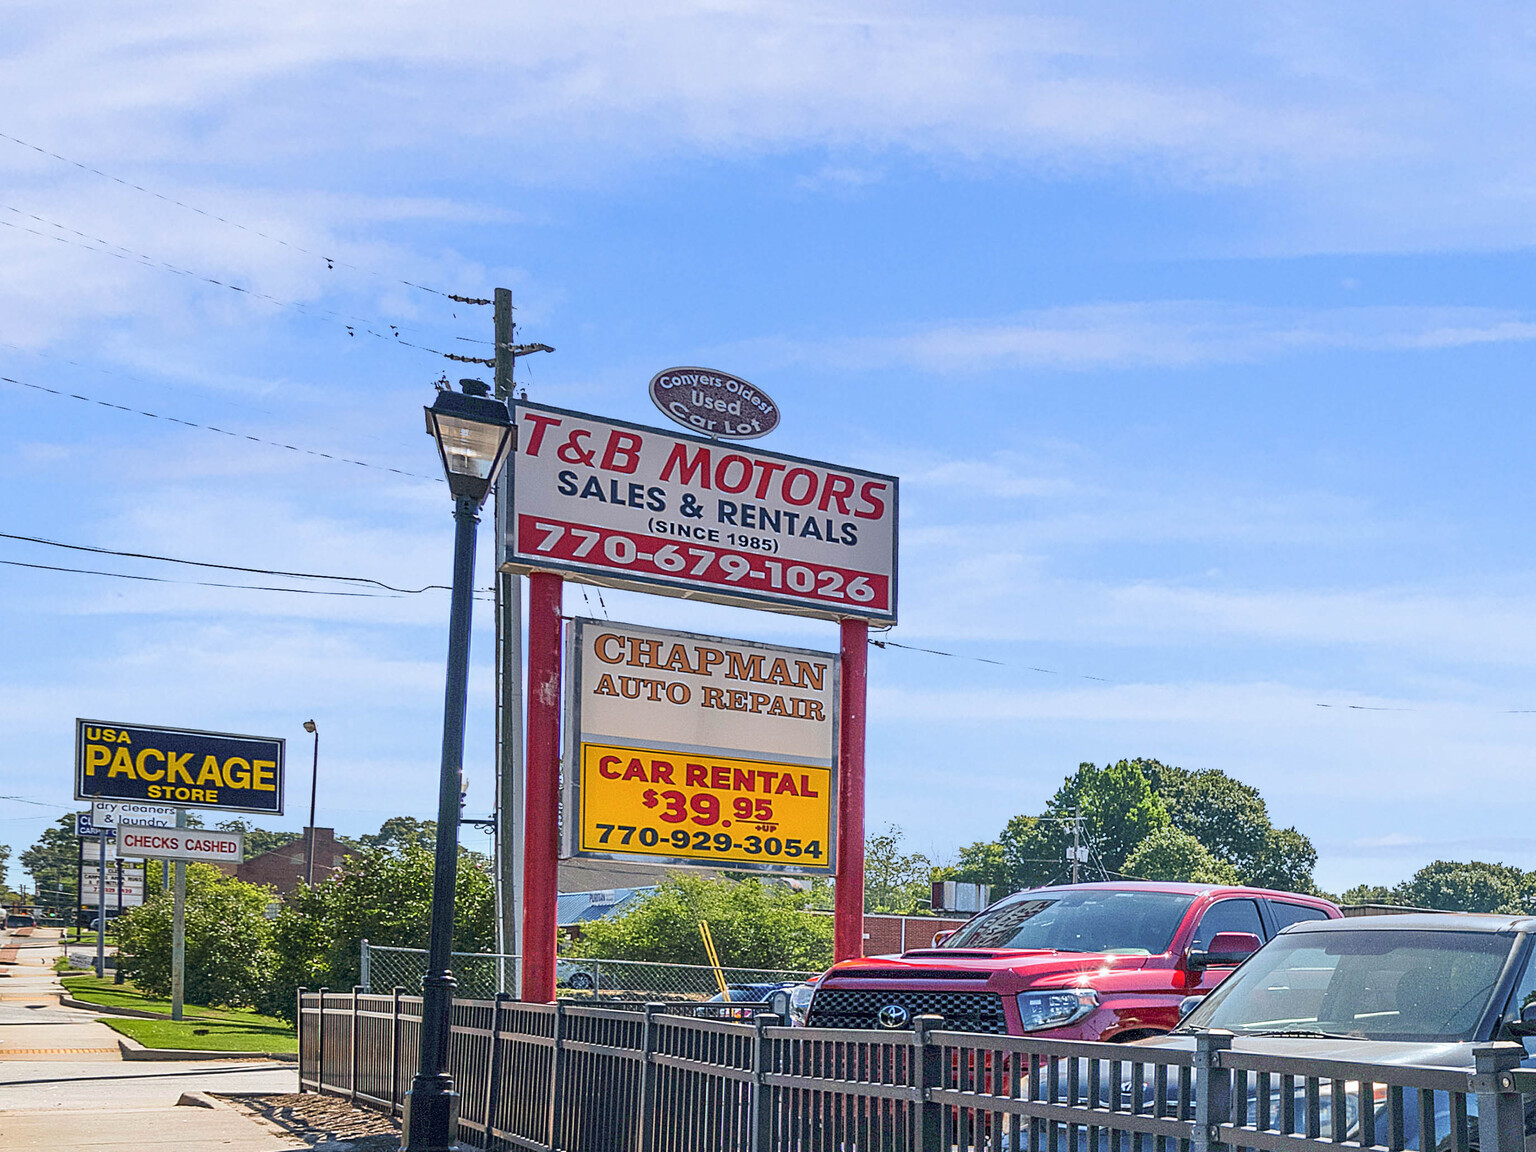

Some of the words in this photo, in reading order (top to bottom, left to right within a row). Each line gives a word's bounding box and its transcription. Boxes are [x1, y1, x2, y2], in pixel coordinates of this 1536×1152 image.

[660, 374, 722, 389] Conyers
[726, 380, 774, 414] Oldest
[691, 389, 741, 416] Used
[669, 401, 717, 430] Car
[724, 417, 761, 434] Lot
[524, 413, 643, 474] T&B
[660, 442, 888, 520] MOTORS
[557, 470, 666, 512] SALES
[680, 493, 704, 519] &
[718, 500, 859, 547] RENTALS
[648, 517, 719, 543] (SINCE
[728, 533, 779, 554] 1985)
[535, 522, 875, 602] 770-679-1026
[594, 633, 827, 691] CHAPMAN
[594, 674, 691, 705] AUTO
[701, 686, 826, 721] REPAIR
[86, 727, 132, 744] USA
[85, 744, 277, 792] PACKAGE
[599, 756, 675, 786] CAR
[686, 763, 818, 798] RENTAL
[96, 803, 117, 812] dry
[121, 804, 176, 815] cleaners
[147, 785, 218, 803] STORE
[104, 814, 114, 823] &
[119, 815, 168, 827] laundry
[124, 835, 179, 850] CHECKS
[184, 839, 237, 854] CASHED
[596, 823, 823, 859] 770-929-3054
